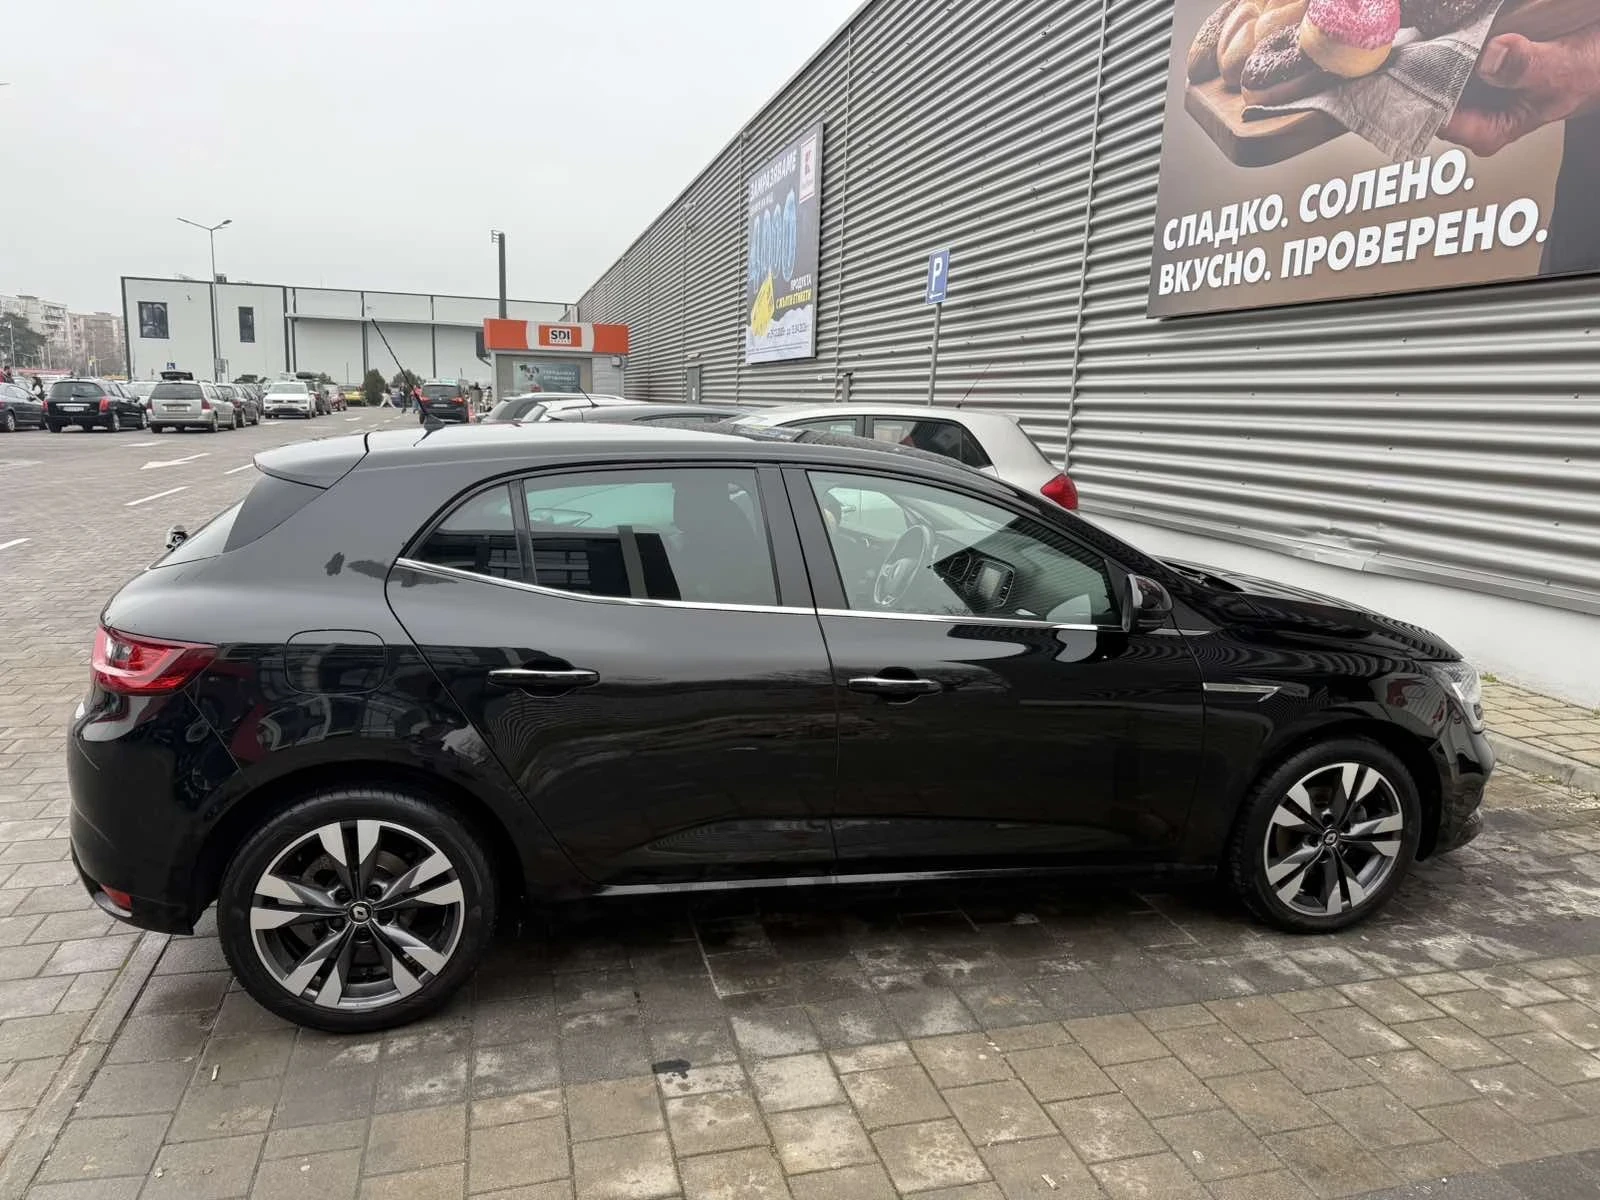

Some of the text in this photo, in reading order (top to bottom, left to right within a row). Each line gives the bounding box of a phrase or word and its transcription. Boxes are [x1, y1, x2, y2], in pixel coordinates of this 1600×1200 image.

[1163, 149, 1474, 251] СЛАДКО. СОЛЕНО.
[932, 257, 943, 291] P
[1158, 198, 1548, 295] ВКУСНО. ПРОВЕРЕНО.
[551, 330, 570, 340] SDI
